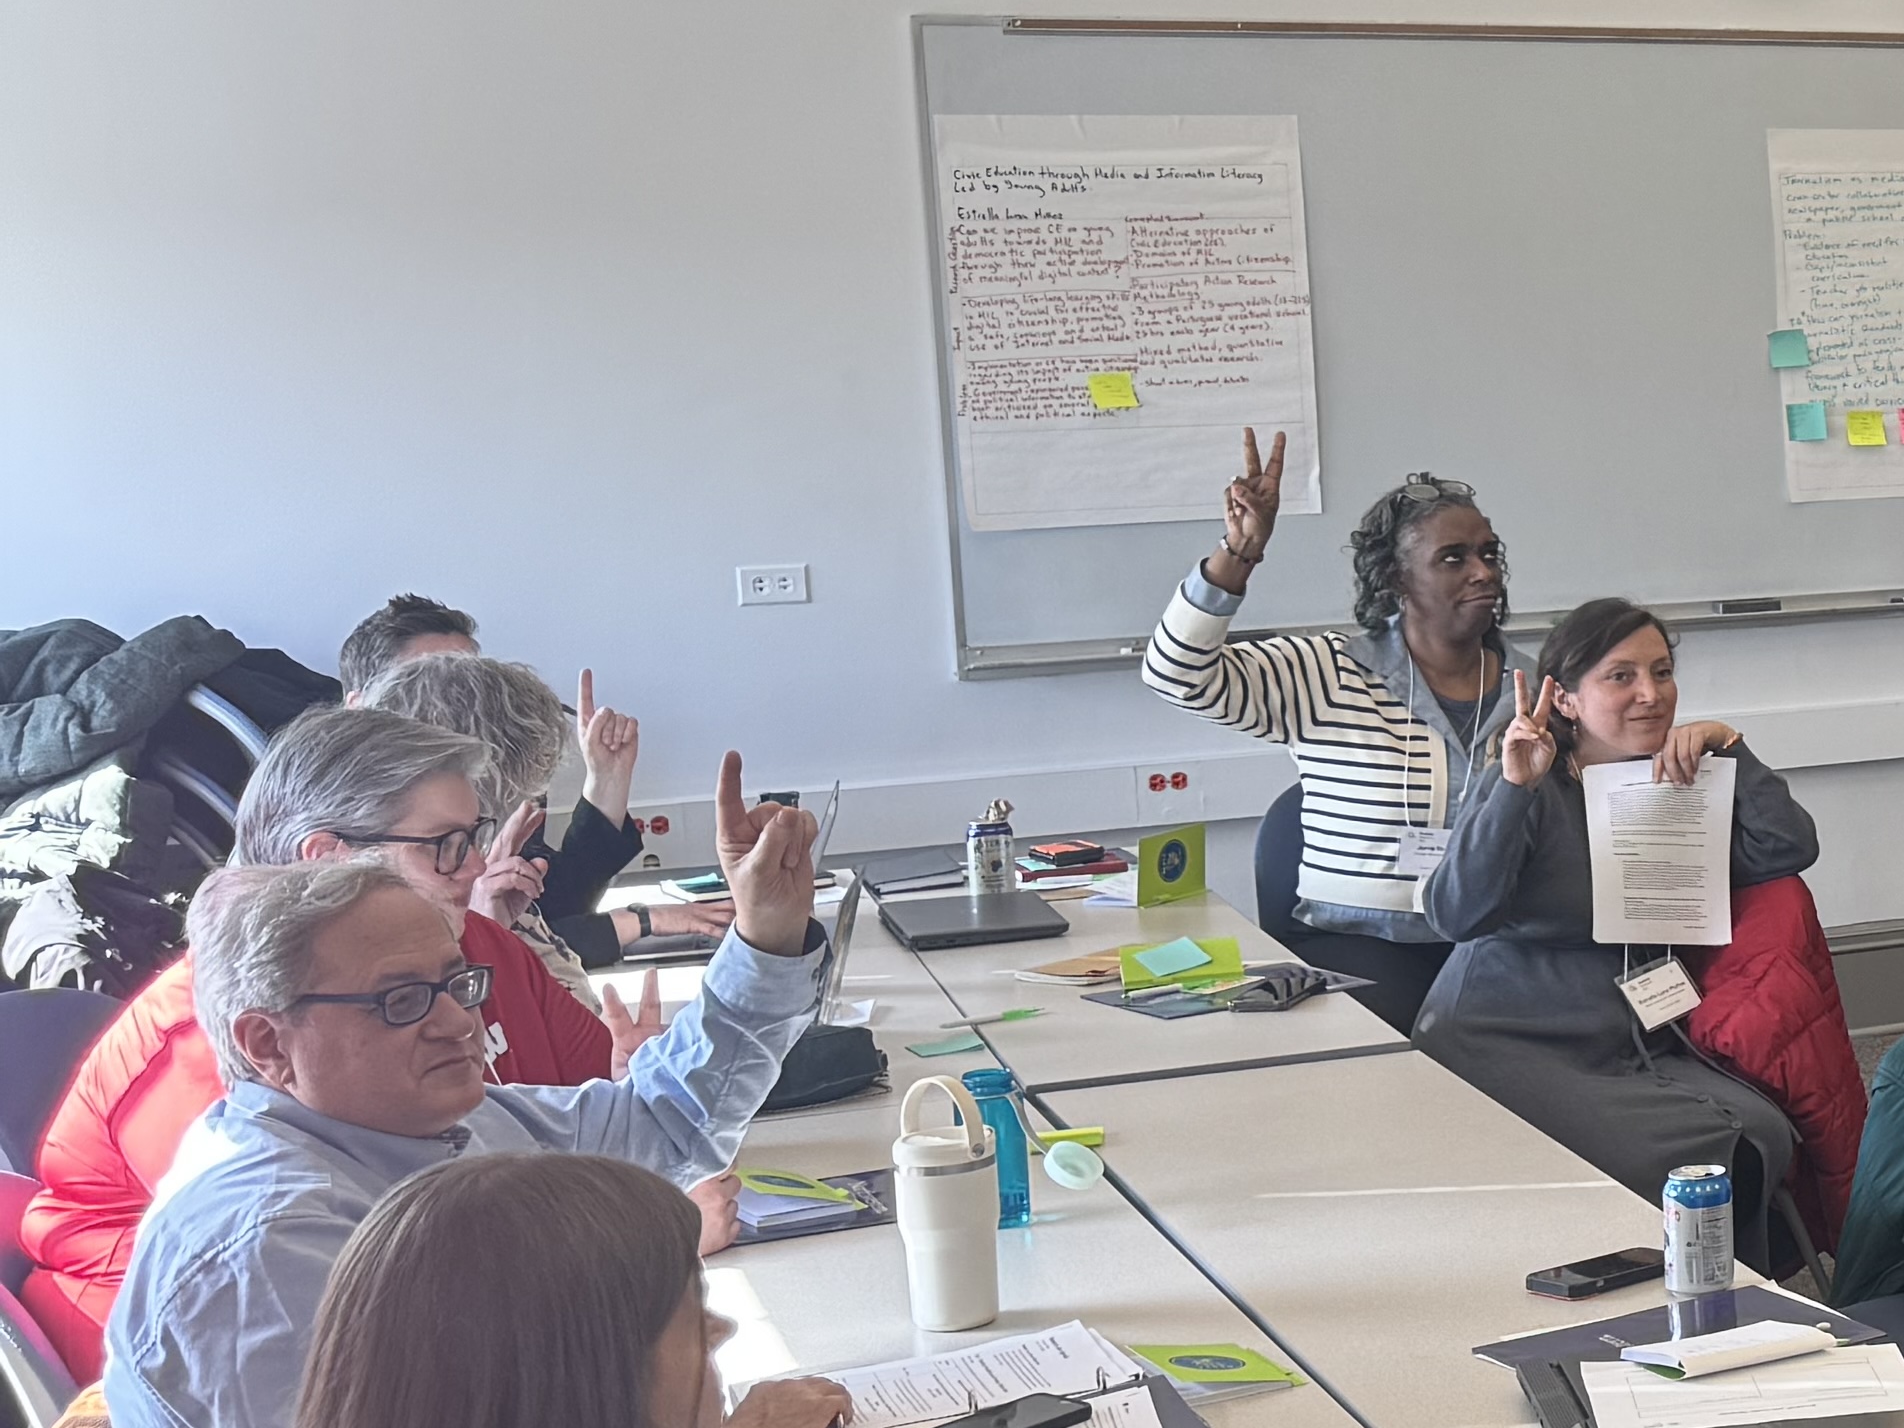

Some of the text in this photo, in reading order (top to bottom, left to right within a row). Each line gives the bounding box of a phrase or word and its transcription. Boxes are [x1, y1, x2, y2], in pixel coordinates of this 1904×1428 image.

[986, 166, 1034, 178] Education
[1038, 166, 1089, 187] through
[983, 182, 999, 193] by
